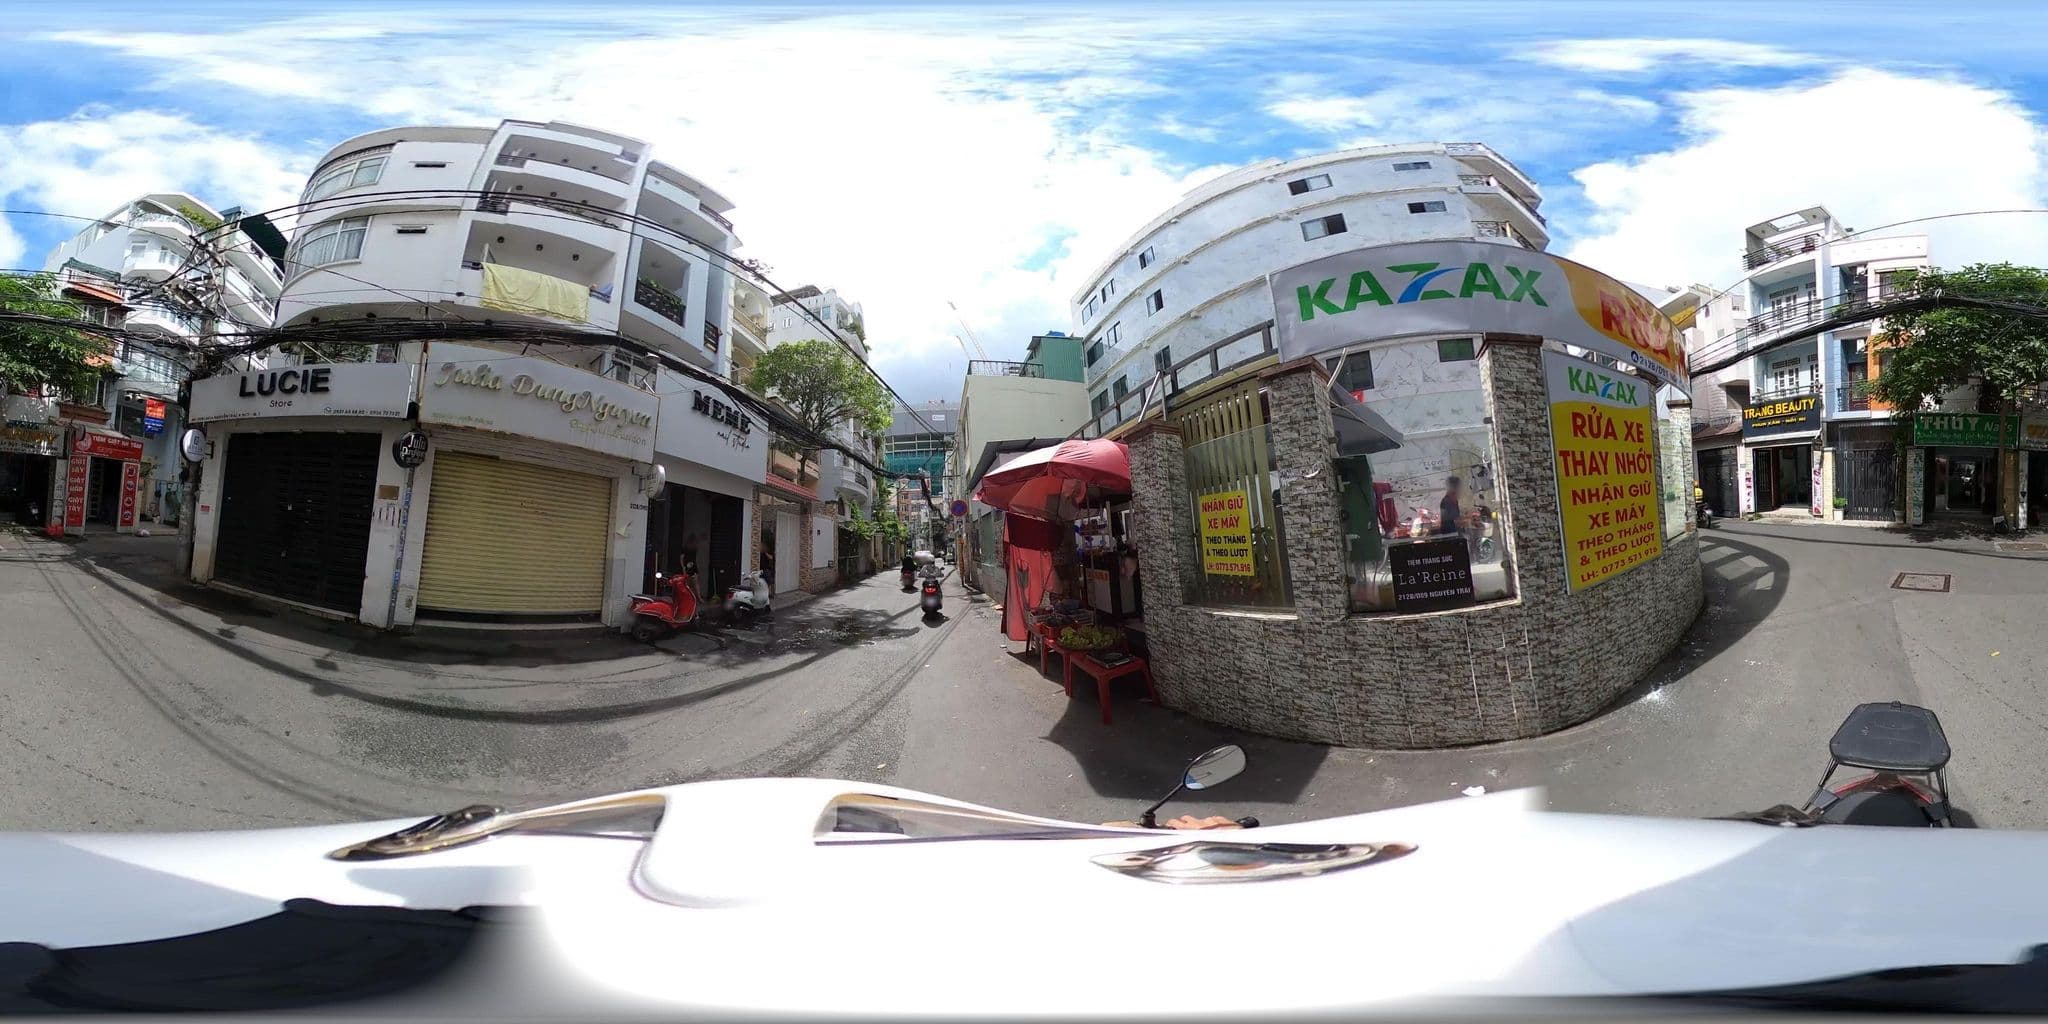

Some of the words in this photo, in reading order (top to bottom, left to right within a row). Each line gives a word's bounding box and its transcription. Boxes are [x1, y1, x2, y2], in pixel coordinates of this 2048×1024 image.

[1296, 262, 1548, 322] KAZAX
[238, 367, 332, 398] LUCIE
[435, 362, 501, 391] Julia
[1567, 366, 1637, 406] KAZAX
[269, 400, 294, 408] Store
[691, 389, 751, 435] MEME
[1744, 405, 1774, 419] TRANG
[1775, 399, 1815, 414] BEAUTY
[1571, 405, 1619, 441] RỬA
[1623, 420, 1645, 443] XE
[1558, 449, 1609, 477] THAY
[1614, 447, 1653, 475] NHỚT
[1571, 482, 1624, 506] NHẬN
[1628, 480, 1652, 498] GIỮ
[1208, 518, 1219, 529] XE
[1221, 514, 1240, 529] MÁY
[1588, 511, 1611, 530] XE
[1615, 502, 1646, 524] MÁY
[1206, 536, 1222, 545] THEO
[1577, 532, 1614, 551] THEO
[1616, 521, 1654, 539] THÁNG
[1580, 555, 1591, 567] &
[1594, 543, 1628, 561] THEO
[1630, 533, 1656, 549] LƯỢT
[1213, 549, 1229, 557] THEO
